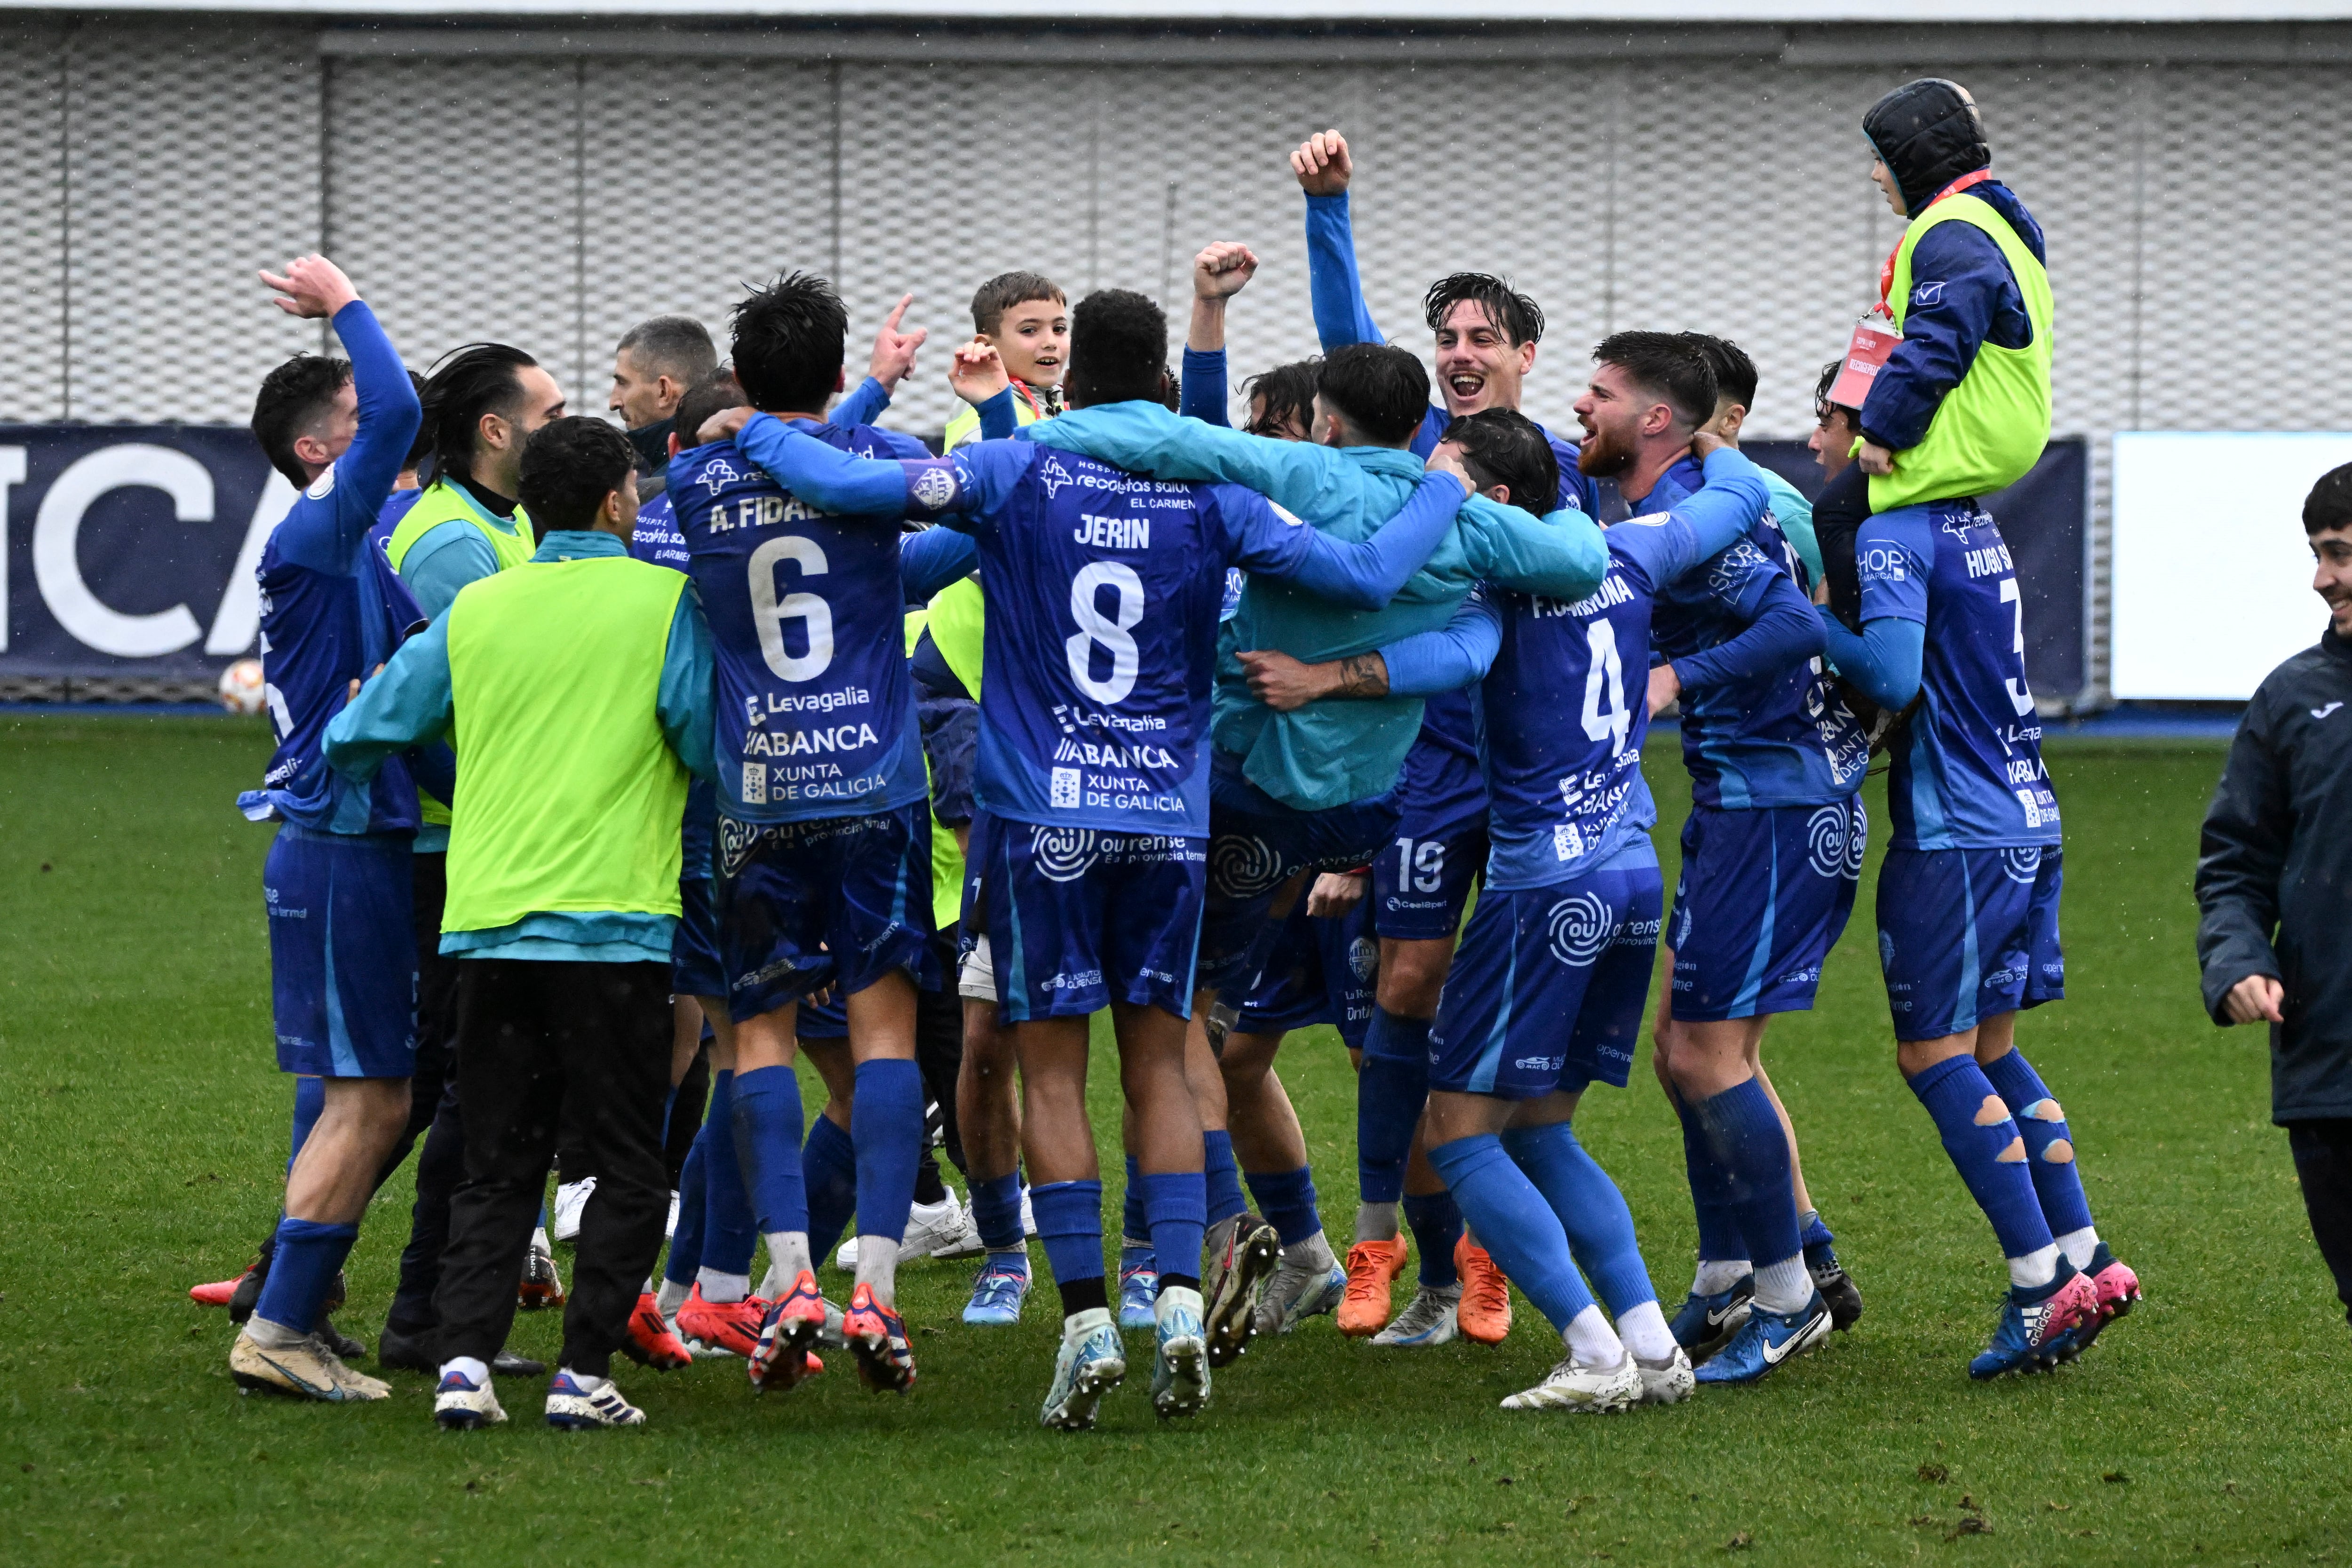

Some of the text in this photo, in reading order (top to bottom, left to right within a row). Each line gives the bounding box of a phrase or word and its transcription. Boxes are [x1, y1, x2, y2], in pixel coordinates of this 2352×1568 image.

[1131, 498, 1196, 509] EL CARMEN
[1074, 514, 1149, 549] JERIN
[1856, 549, 1904, 577] HOP
[1965, 548, 2002, 578] HUGO
[747, 535, 834, 682] 6
[1066, 561, 1144, 705] 8
[768, 686, 870, 713] Levagalia
[1581, 618, 1631, 757] 4
[753, 723, 879, 756] ABANCA
[1067, 741, 1179, 769] ABANCA
[773, 764, 843, 782] XUNTA
[1840, 759, 1860, 779] DE
[774, 774, 886, 800] DE GALICIA
[1088, 774, 1150, 792] XUNTA
[1087, 792, 1185, 812] DE GALICIA
[2040, 808, 2049, 822] DE
[1186, 850, 1207, 862] terma
[1395, 837, 1446, 892] 19
[1613, 919, 1662, 937] orens
[2030, 1302, 2055, 1346] adidas
